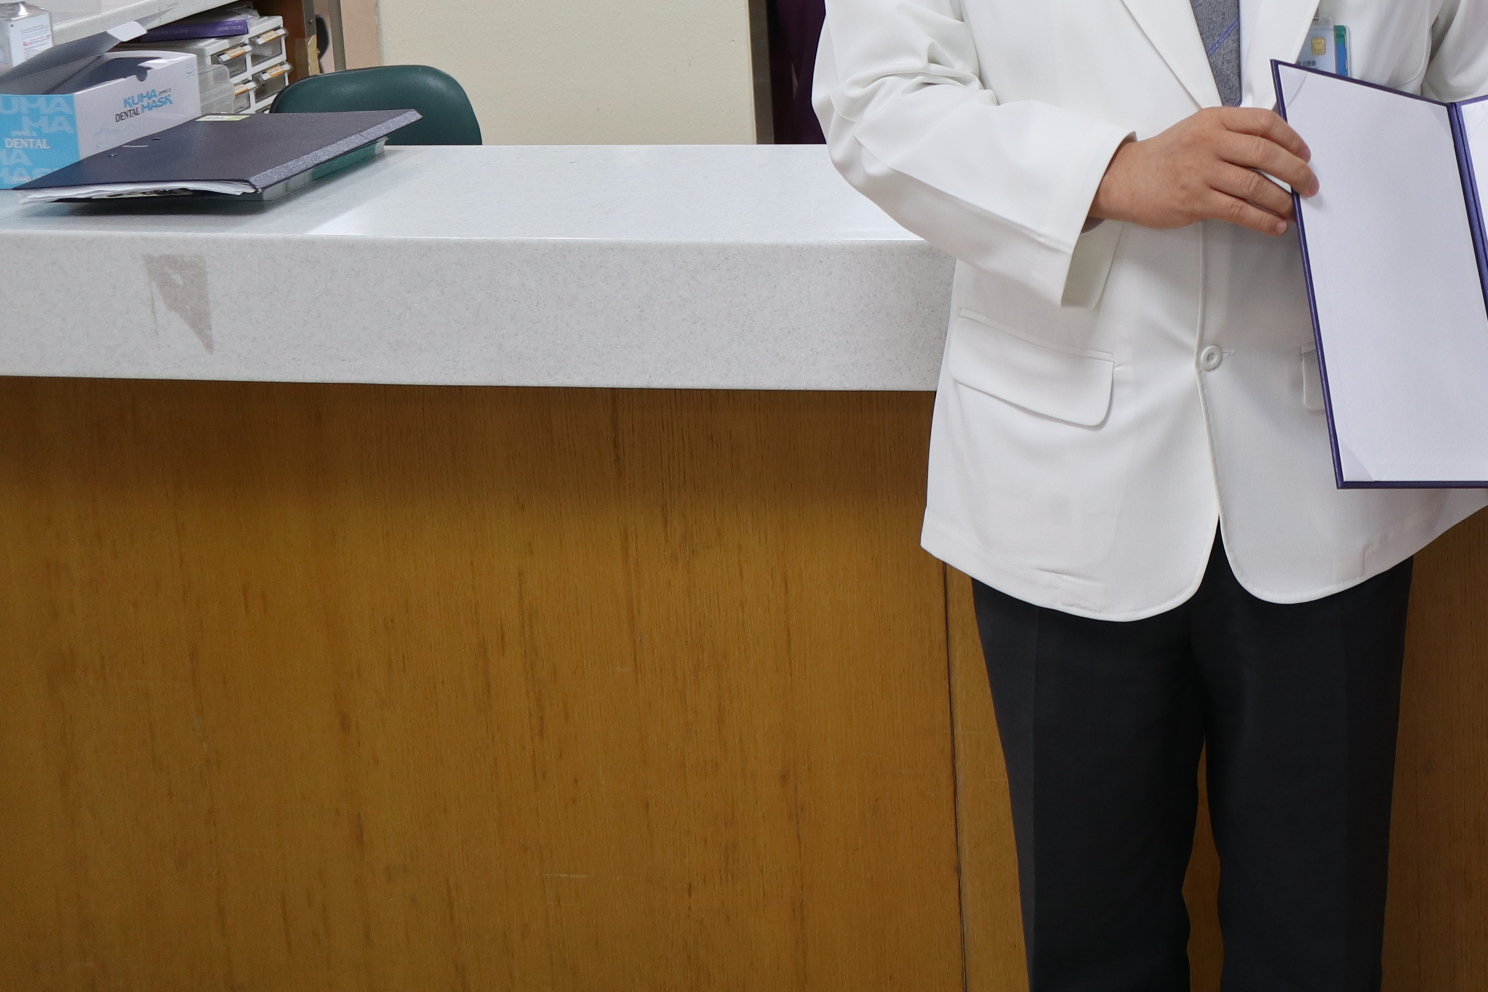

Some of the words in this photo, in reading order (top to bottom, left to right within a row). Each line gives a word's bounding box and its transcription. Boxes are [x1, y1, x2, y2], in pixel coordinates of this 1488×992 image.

[122, 88, 159, 108] KUMA
[115, 107, 141, 123] DENTAL
[141, 94, 174, 113] MASK
[4, 138, 50, 150] DENTAL
